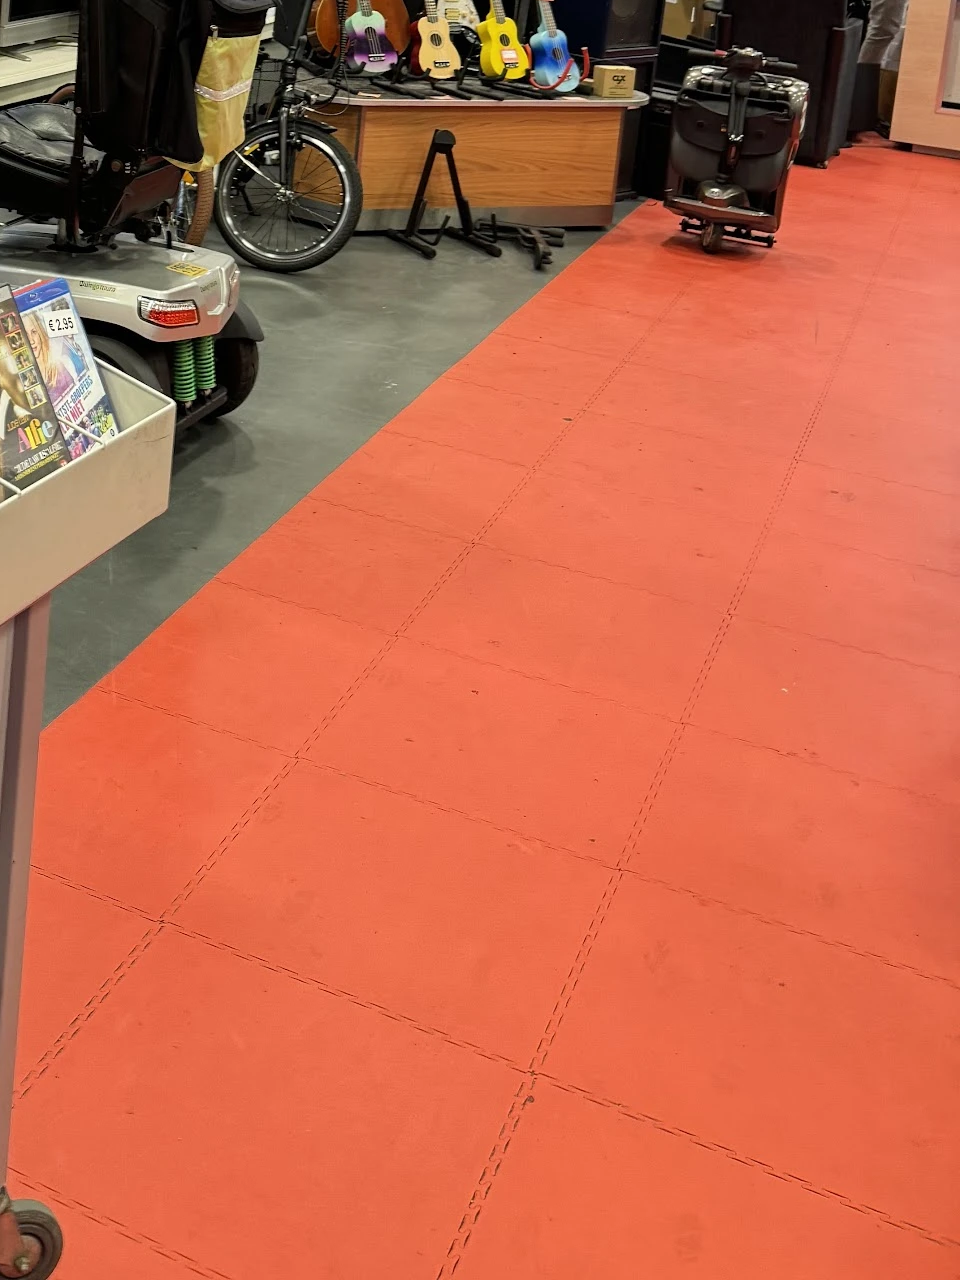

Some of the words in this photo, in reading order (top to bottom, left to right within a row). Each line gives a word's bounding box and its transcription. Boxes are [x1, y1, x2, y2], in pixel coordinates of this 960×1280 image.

[49, 321, 56, 332] €
[56, 317, 74, 331] 2.95
[70, 398, 86, 424] NIET
[17, 418, 54, 453] Alfie
